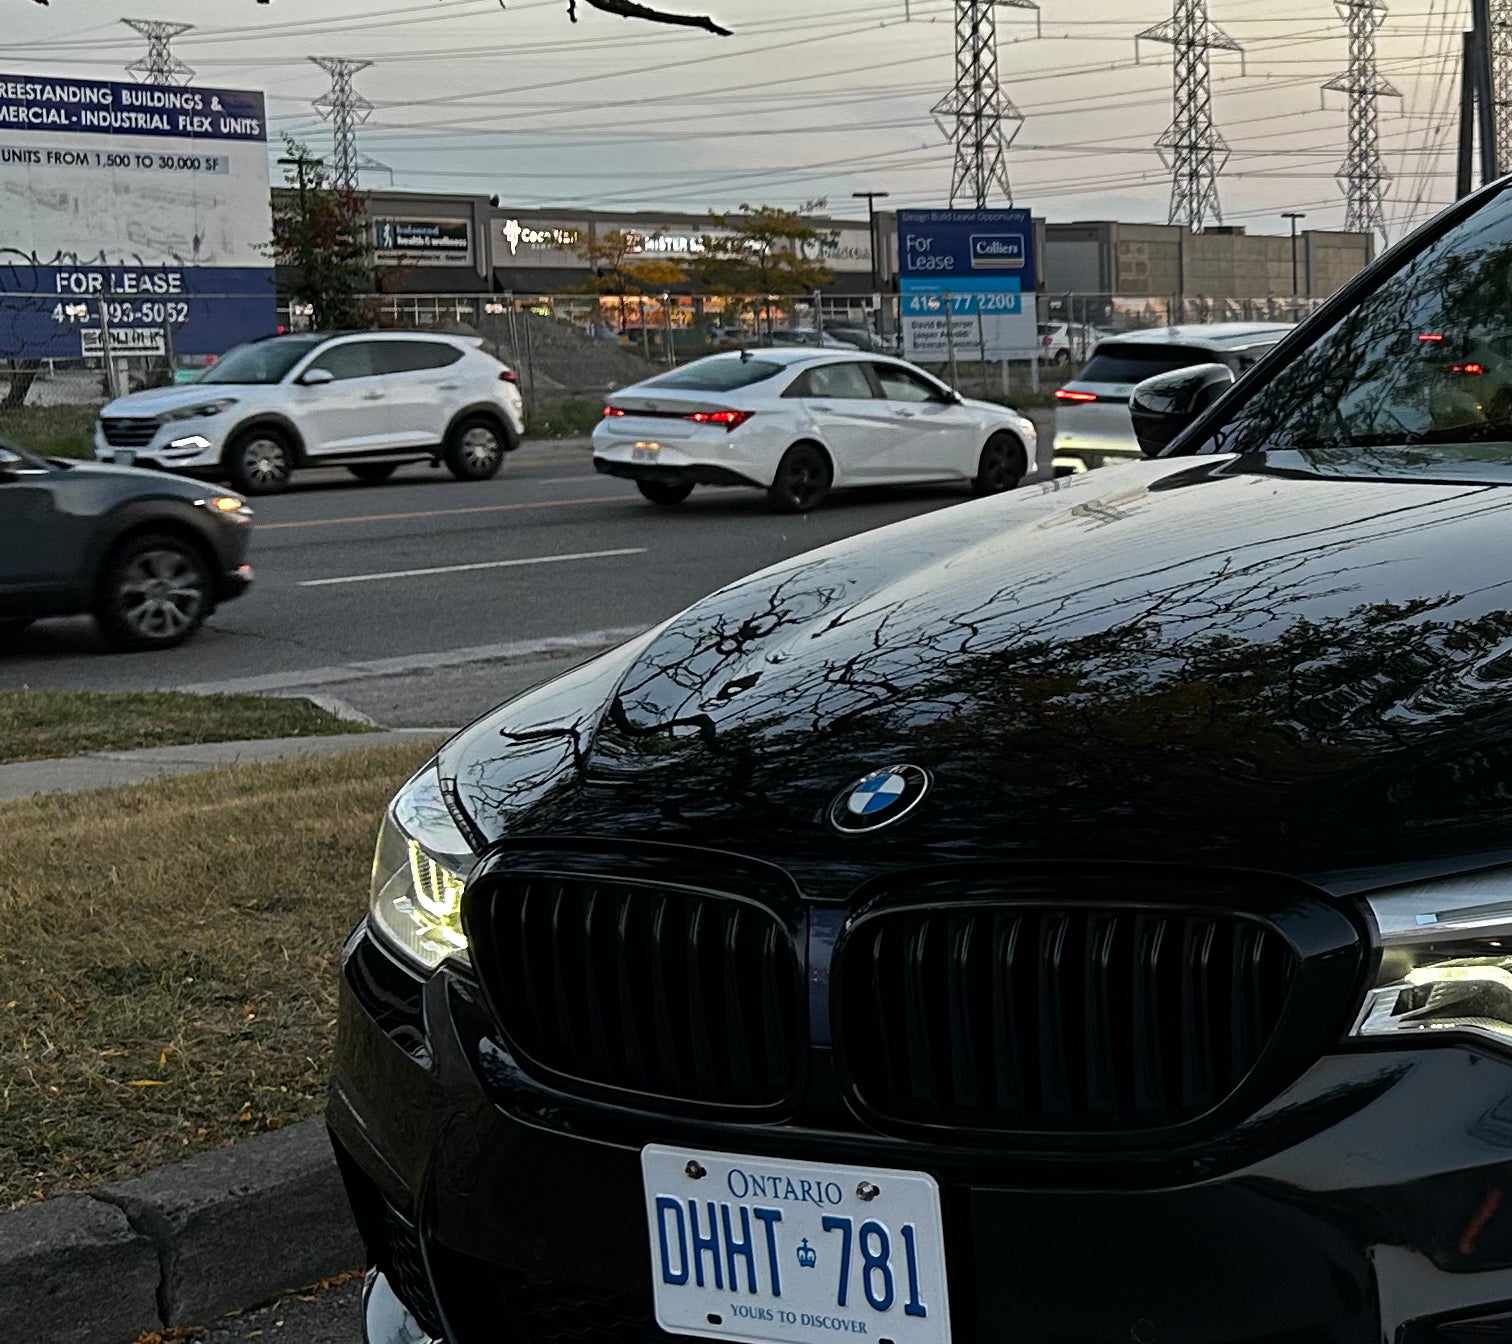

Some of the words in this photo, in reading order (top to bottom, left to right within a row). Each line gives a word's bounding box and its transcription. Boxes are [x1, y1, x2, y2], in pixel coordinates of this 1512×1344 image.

[121, 89, 204, 110] BUILDINGS
[211, 96, 222, 111] &
[81, 109, 171, 130] INDUSTRIAL
[179, 115, 212, 132] FLEX
[220, 117, 260, 135] UNITS
[1, 149, 42, 164] UNITS
[47, 151, 90, 166] FROM
[95, 153, 131, 168] 1,500
[135, 156, 153, 168] TO
[159, 156, 201, 170] 30,000
[205, 157, 219, 171] SF
[906, 234, 934, 252] For
[907, 253, 954, 270] Lease
[56, 272, 103, 293] FOR
[110, 272, 182, 293] LEASE
[51, 302, 188, 323] 4-93-5052
[976, 294, 1015, 310] 2200
[727, 1168, 843, 1208] ONTARIO
[656, 1196, 783, 1298] DHHT
[822, 1215, 927, 1318] 781
[730, 1304, 774, 1322] YOURS
[777, 1309, 797, 1324] TO
[801, 1312, 868, 1334] DISCOVER
